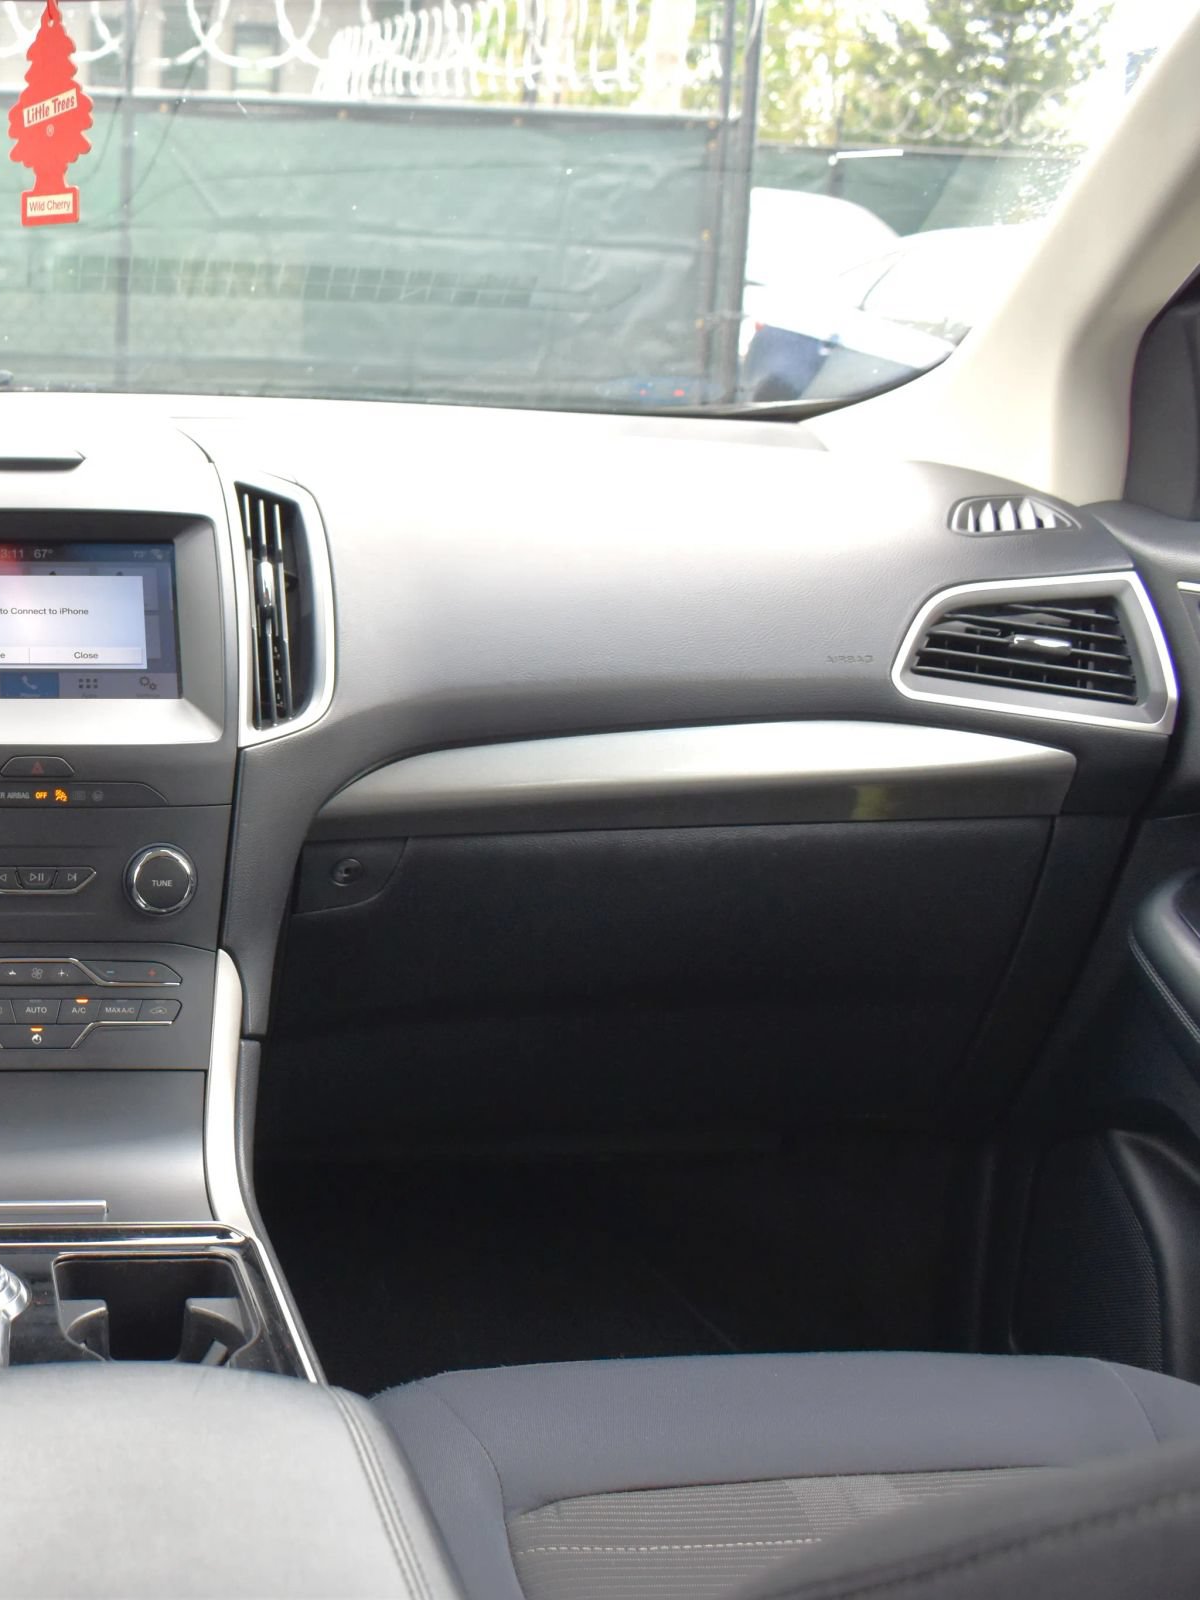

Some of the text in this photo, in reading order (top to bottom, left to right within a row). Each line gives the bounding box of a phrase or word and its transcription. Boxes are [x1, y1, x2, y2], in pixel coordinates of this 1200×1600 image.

[27, 96, 75, 124] Little Trees
[29, 199, 71, 213] Wild Cherry
[0, 607, 9, 615] to
[10, 607, 47, 615] Connect
[49, 607, 58, 615] to
[59, 607, 89, 615] iPhone
[73, 651, 99, 660] Close
[6, 791, 30, 799] AIRBAG
[35, 791, 48, 799] OFF
[151, 879, 173, 887] TUNE
[25, 1006, 48, 1014] AUTO
[71, 1006, 87, 1014] A/C
